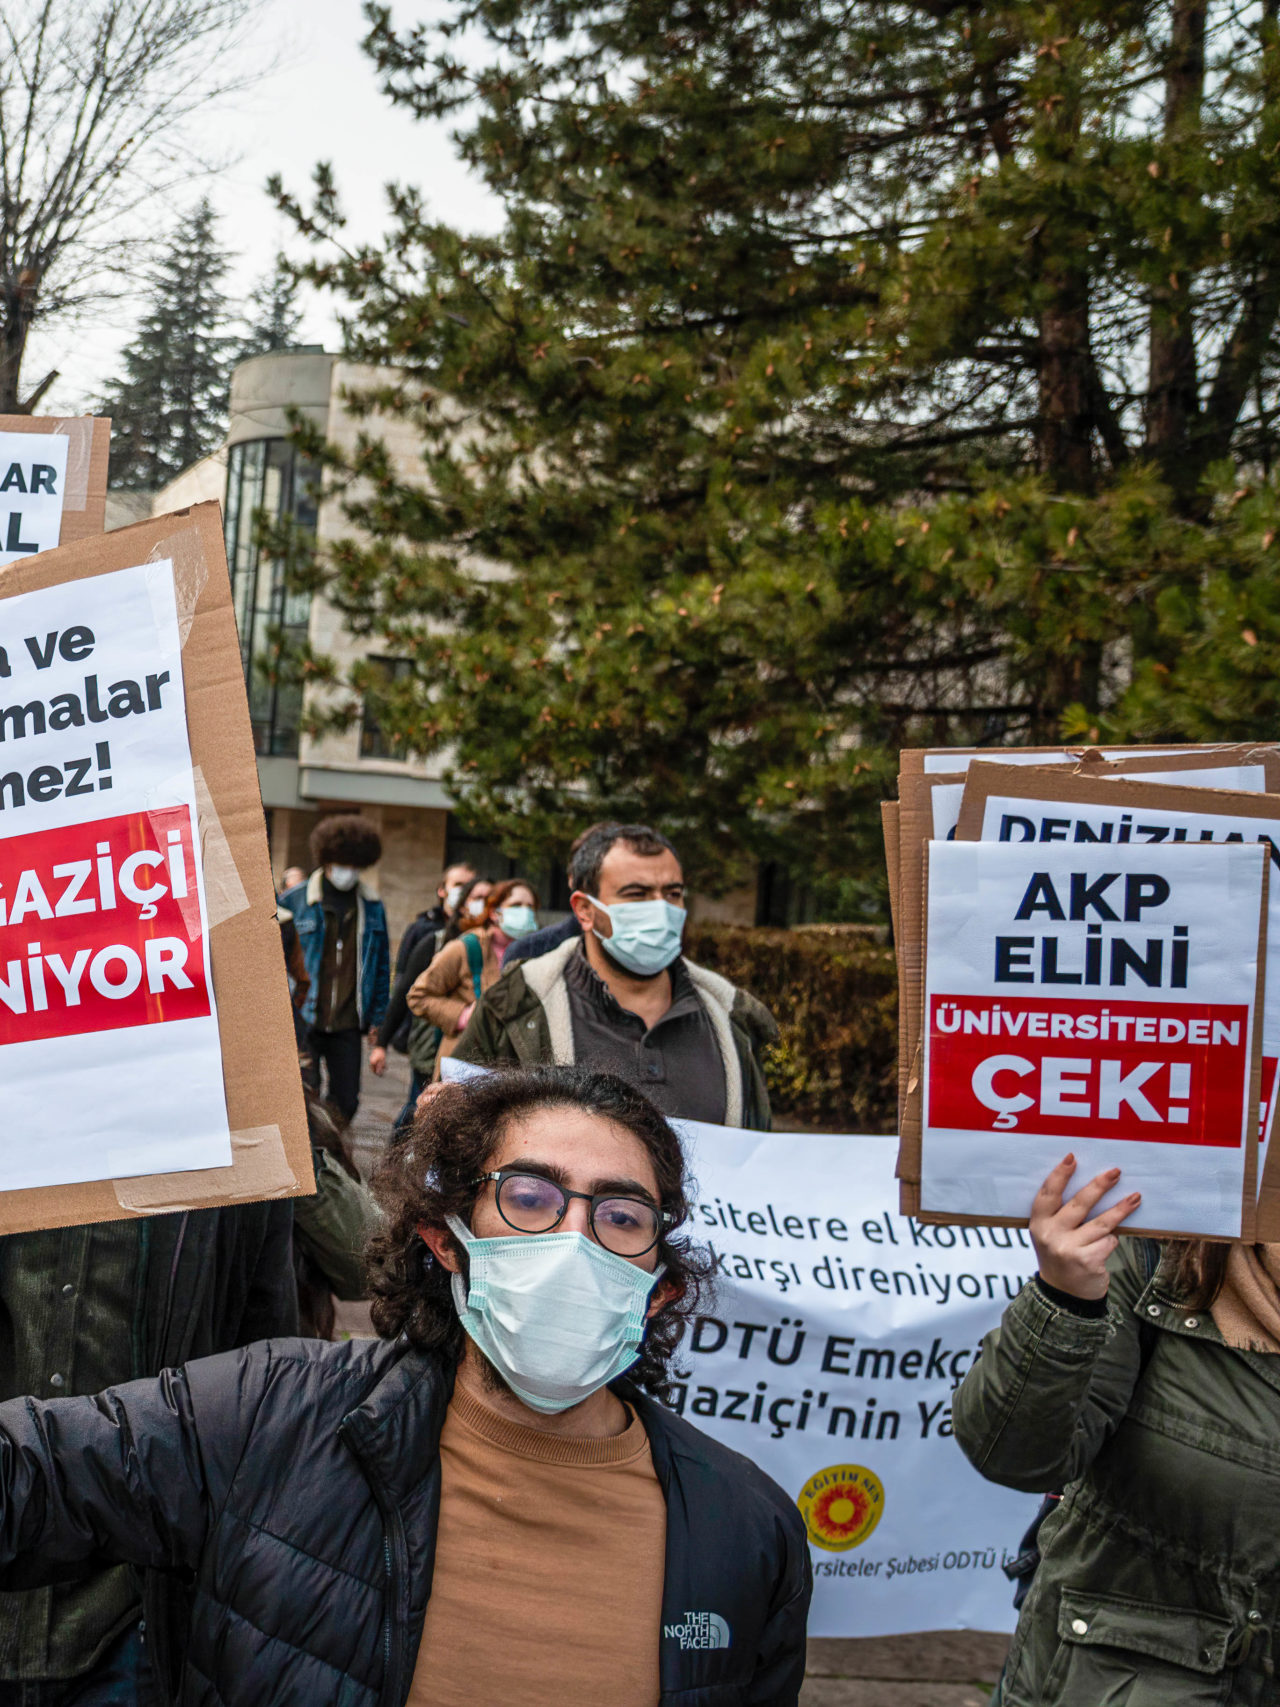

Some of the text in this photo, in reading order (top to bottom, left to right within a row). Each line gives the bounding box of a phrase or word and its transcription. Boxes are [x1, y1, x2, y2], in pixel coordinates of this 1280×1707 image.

[24, 623, 96, 669] ve
[999, 814, 1280, 863] DENİ
[1014, 871, 1171, 923] AKP
[994, 923, 1189, 989] ELİNİ
[935, 1002, 1241, 1046] ÜNİVERSİTEDEN
[971, 1054, 1192, 1130] ÇEK!
[862, 1211, 899, 1245] el
[708, 1240, 1034, 1304] karşı direniyoru
[917, 1400, 953, 1439] Ya
[885, 1553, 940, 1579] Şubesi
[943, 1547, 996, 1570] ODTÜ
[663, 1624, 709, 1639] NORTH
[683, 1611, 709, 1625] THE
[680, 1636, 709, 1650] FACE
